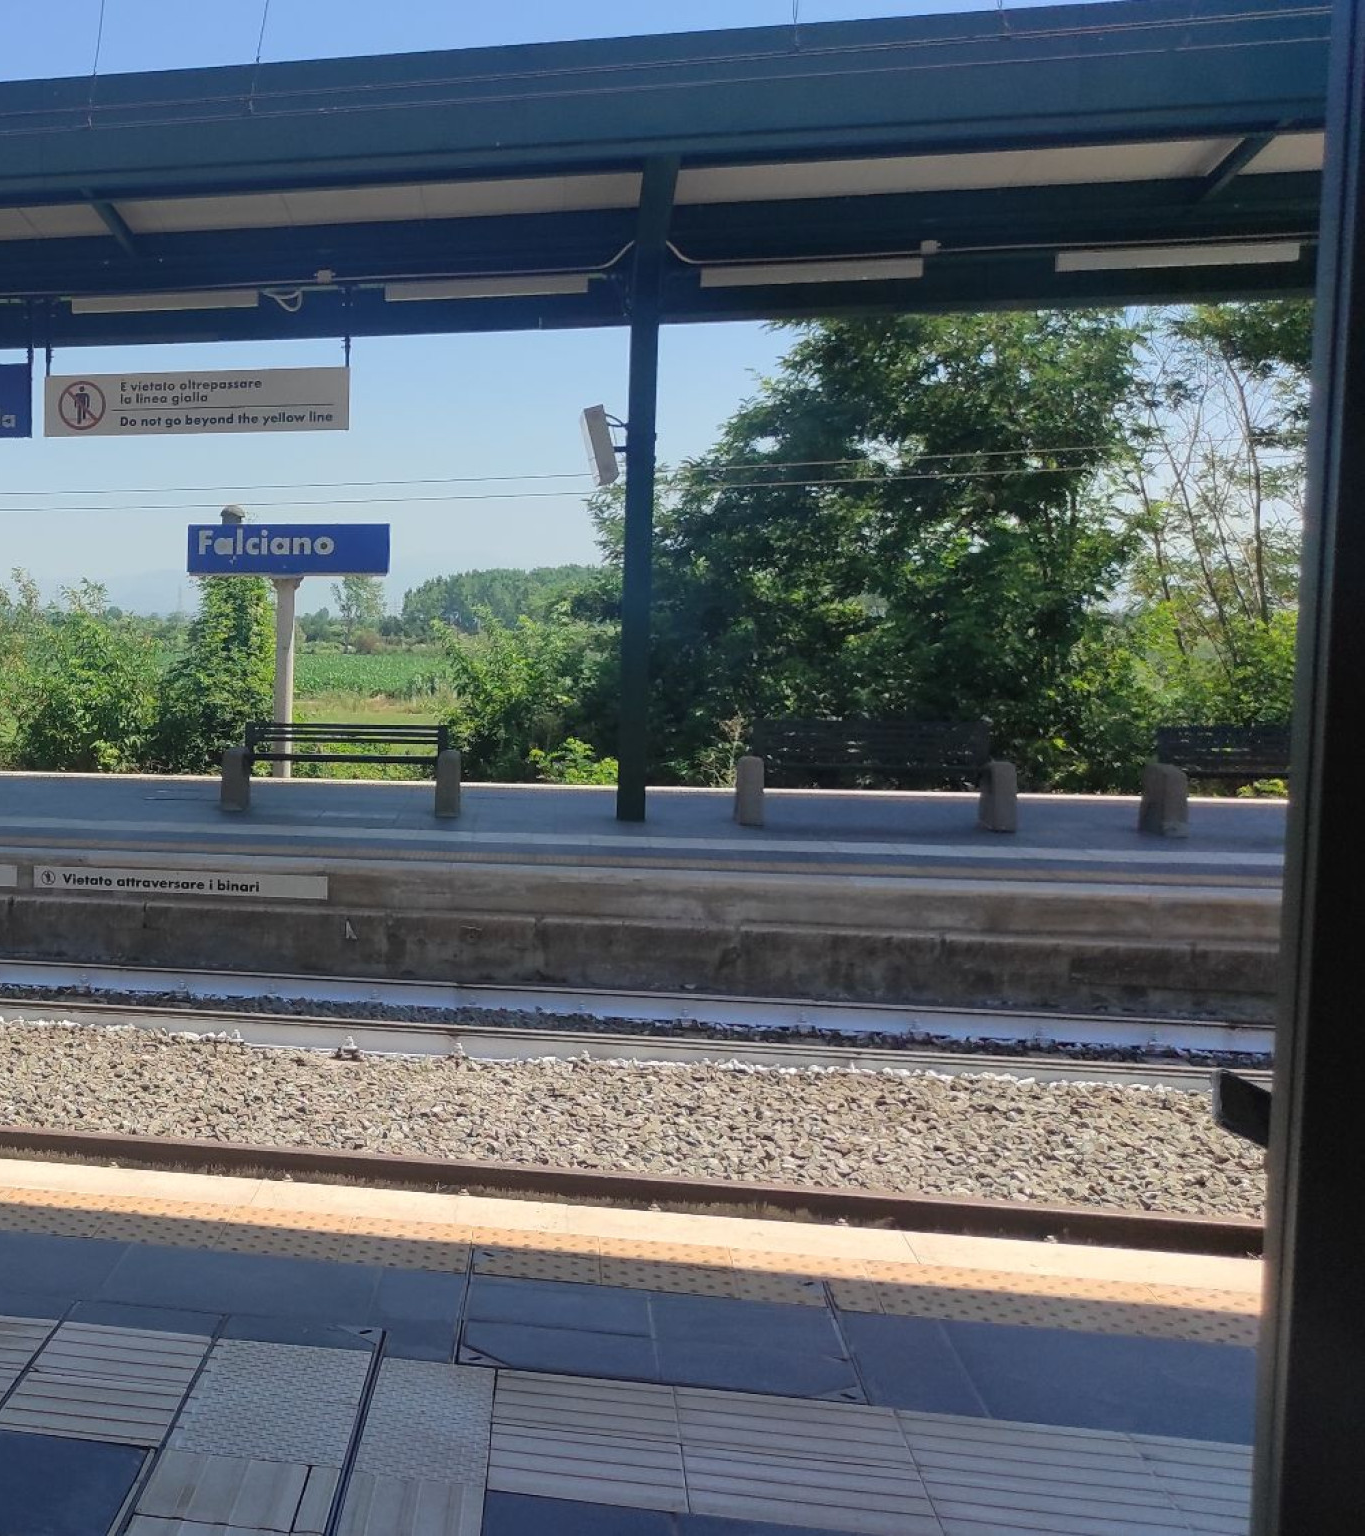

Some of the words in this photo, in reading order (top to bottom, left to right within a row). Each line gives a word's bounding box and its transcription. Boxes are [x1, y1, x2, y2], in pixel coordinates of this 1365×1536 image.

[130, 381, 175, 392] vietato
[179, 379, 262, 391] oltrepassare
[120, 393, 131, 405] la
[136, 393, 167, 404] linea
[172, 391, 208, 406] gialla
[120, 416, 136, 427] Do
[141, 417, 162, 427] not
[165, 417, 181, 429] go
[185, 413, 234, 427] beyond
[238, 413, 258, 424] the
[262, 411, 305, 426] yellow
[309, 410, 333, 422] line
[198, 527, 335, 555] Falciano
[63, 873, 112, 887] Vietato
[116, 877, 205, 890] attraversare
[217, 879, 260, 893] binari
